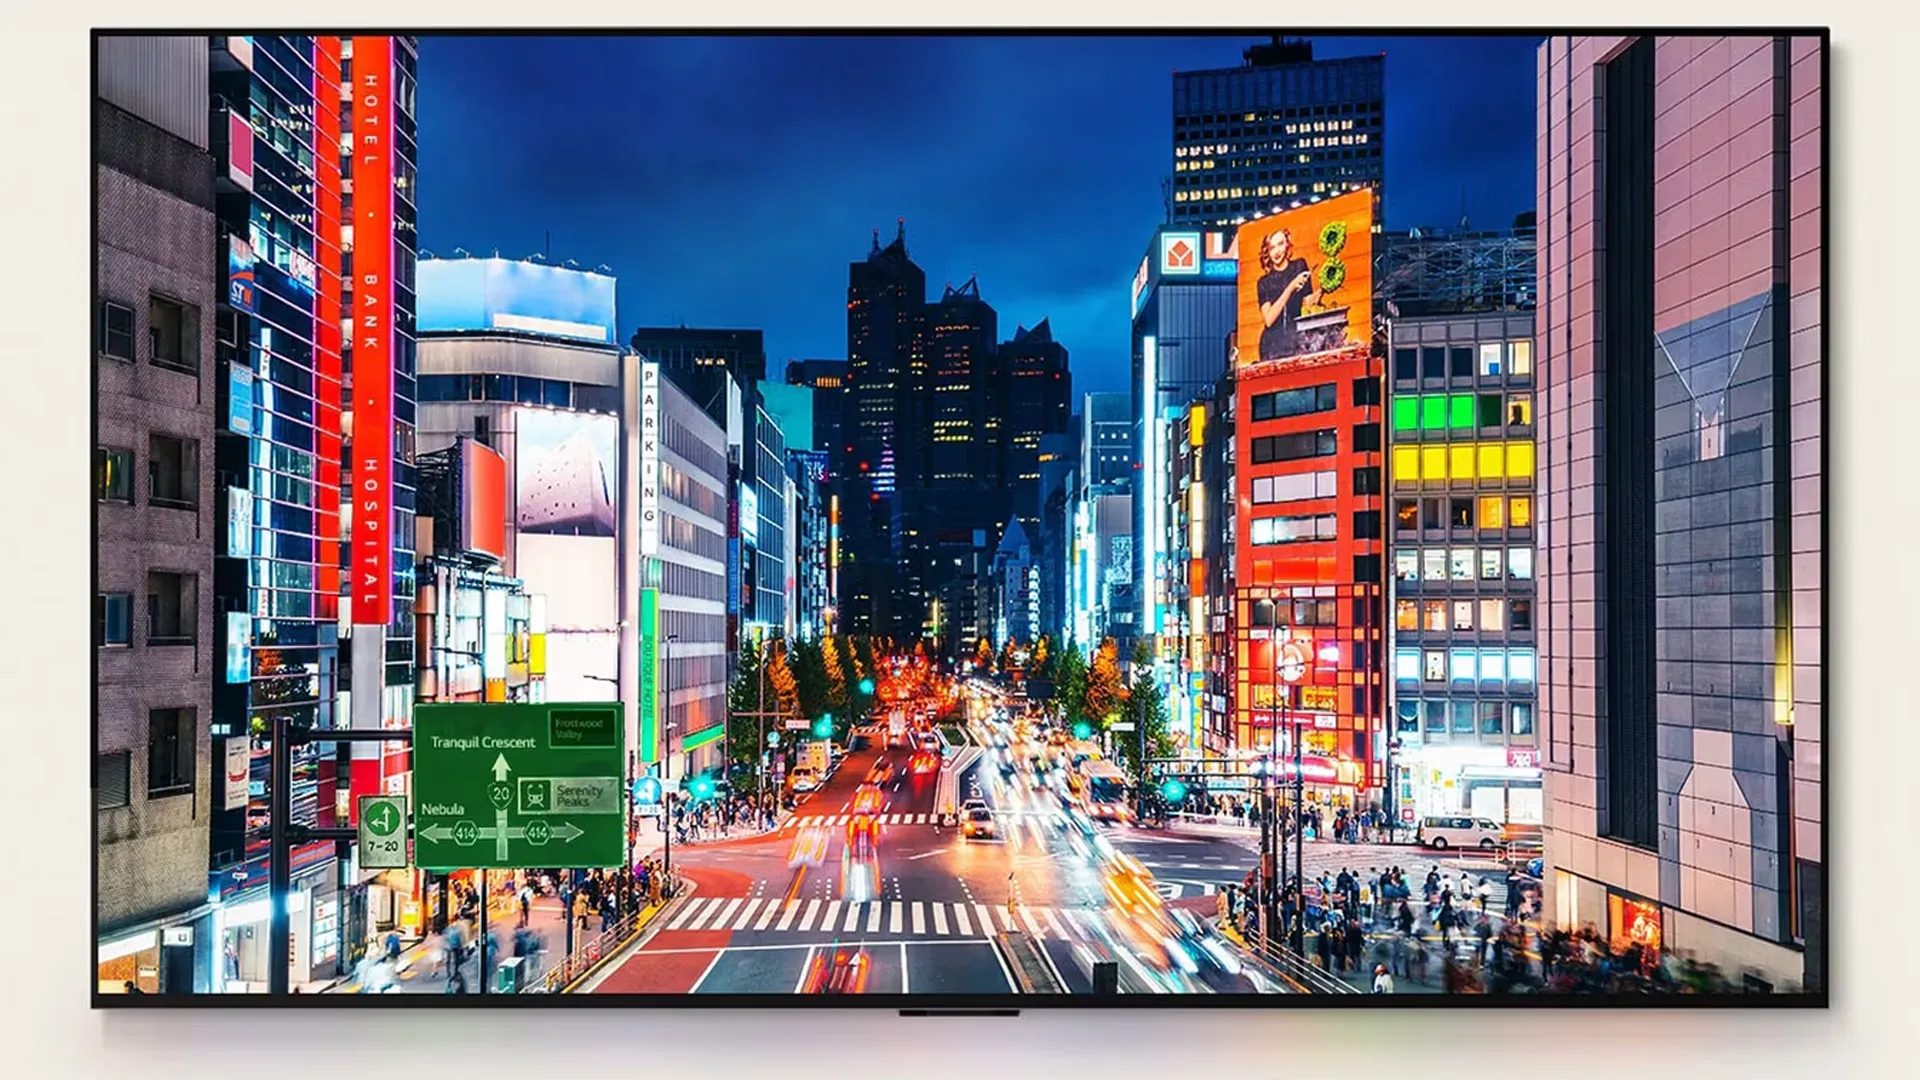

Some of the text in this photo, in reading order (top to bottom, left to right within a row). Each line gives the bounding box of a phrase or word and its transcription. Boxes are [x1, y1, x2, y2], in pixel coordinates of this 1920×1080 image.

[364, 75, 378, 603] HOTEL BANK HOSPITAL
[644, 371, 654, 522] PARKING
[643, 635, 653, 718] BOUTIQUE HOTEL
[555, 719, 603, 729] Frostwood
[555, 730, 583, 742] Valley
[431, 736, 536, 751] Tranquil Crescent
[493, 787, 510, 801] 20
[556, 785, 604, 798] Serenity
[556, 796, 590, 808] Peaks
[421, 803, 465, 816] Nebula
[455, 827, 476, 840] 414
[527, 827, 548, 839] 414
[367, 840, 399, 852] 7-20
